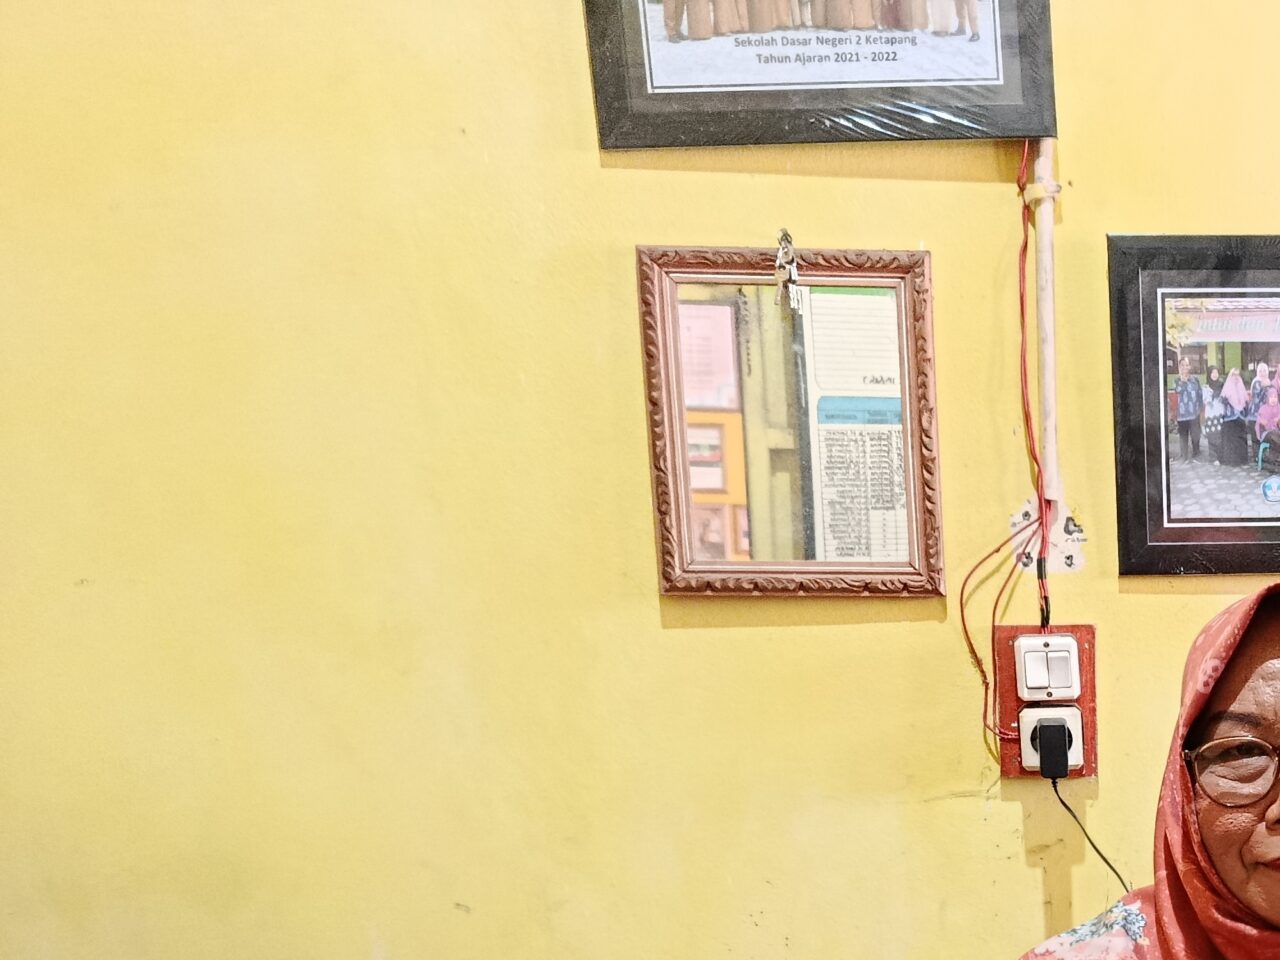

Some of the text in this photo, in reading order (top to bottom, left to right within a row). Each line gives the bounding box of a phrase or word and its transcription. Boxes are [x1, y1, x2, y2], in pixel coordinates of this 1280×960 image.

[734, 35, 917, 48] Sekolah Dasar Negeri 2 Ketapang
[756, 53, 791, 64] Tahun
[794, 53, 830, 65] Ajaran
[834, 52, 860, 62] 2021
[871, 51, 898, 62] 2022
